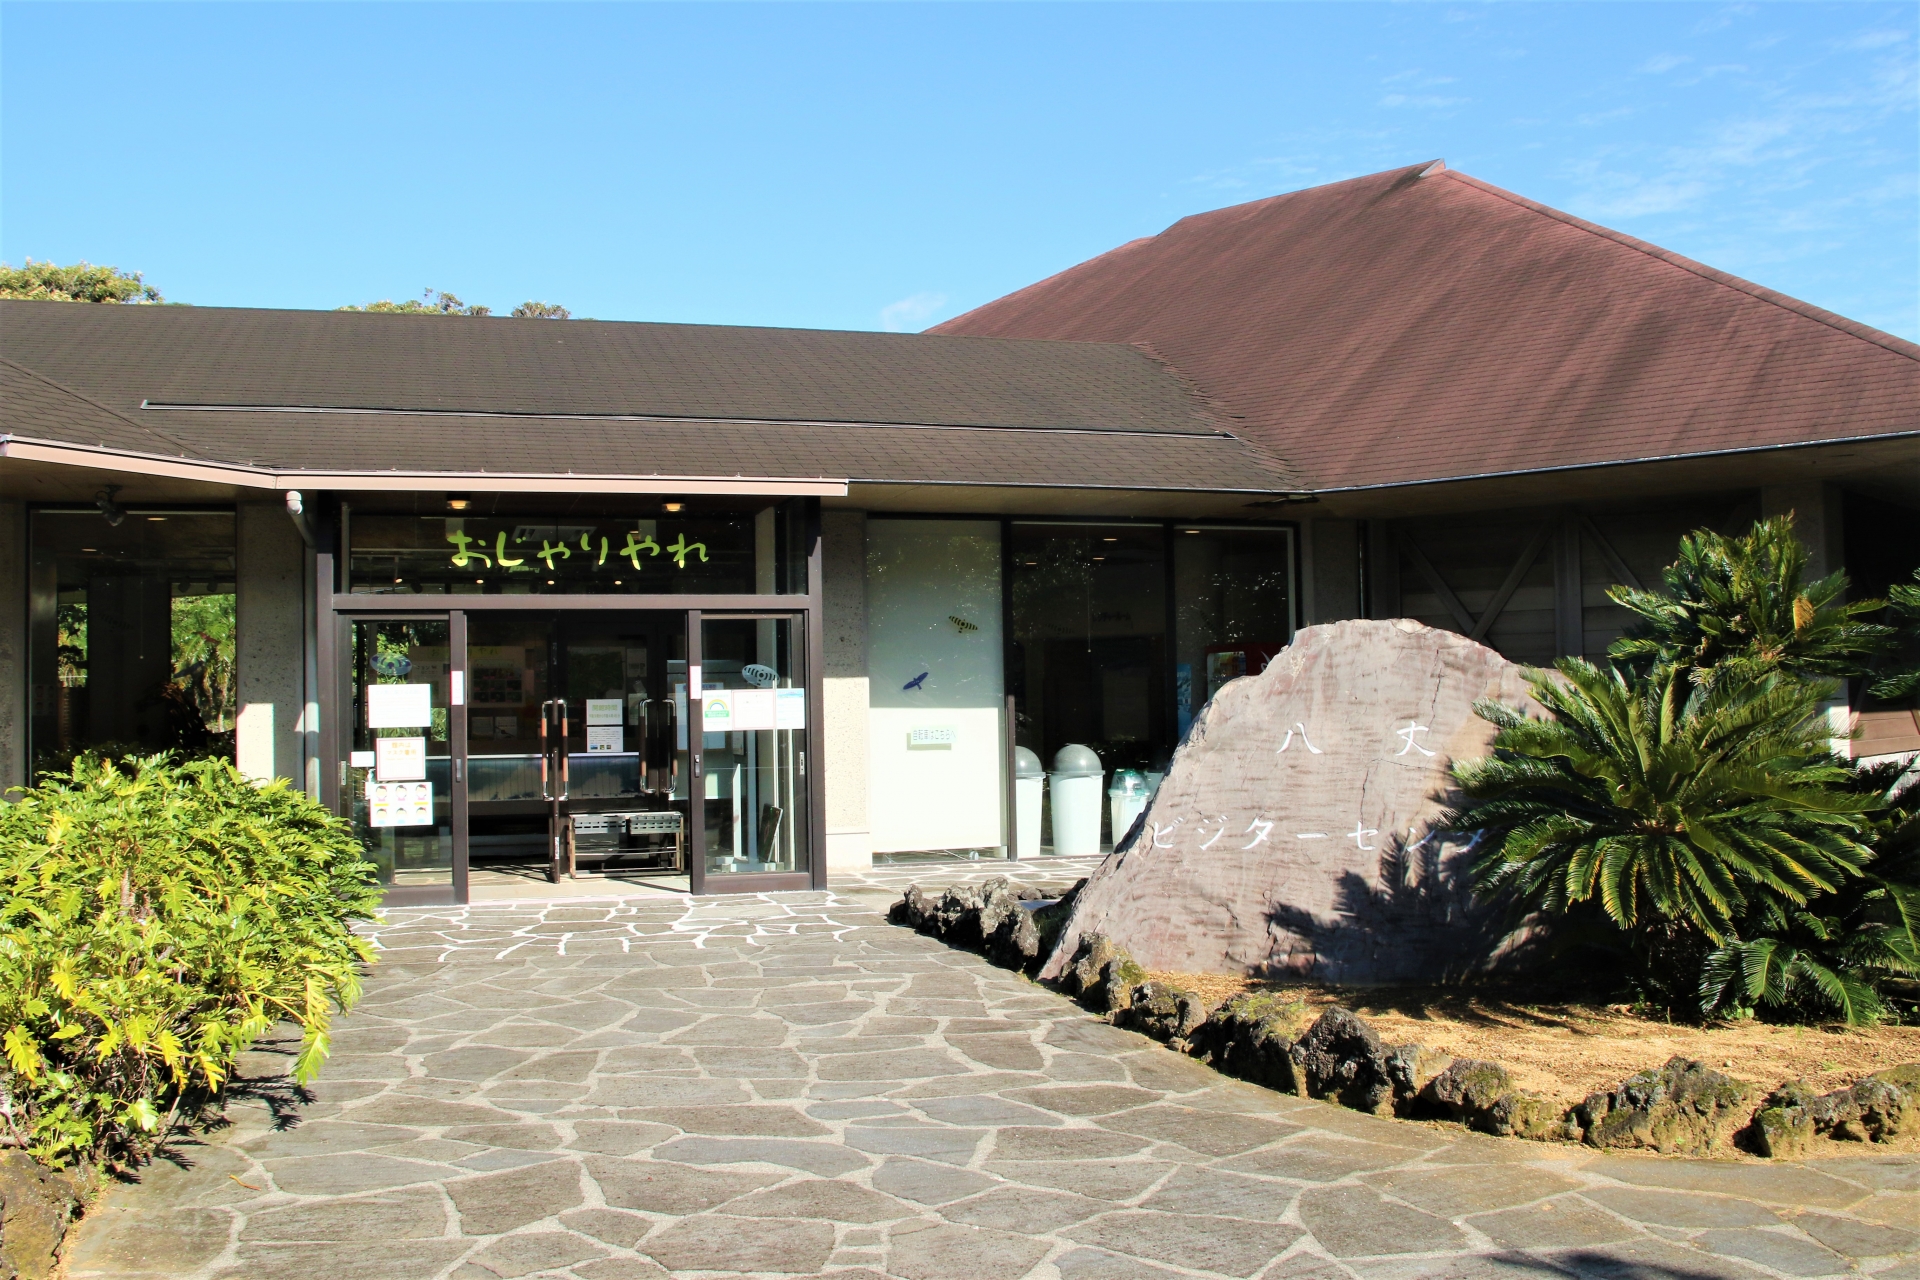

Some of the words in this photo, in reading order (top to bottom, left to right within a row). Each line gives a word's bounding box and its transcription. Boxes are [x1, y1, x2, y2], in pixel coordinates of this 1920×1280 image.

[447, 530, 709, 571] おじゃりやれ
[1277, 720, 1437, 757] 八丈
[1153, 815, 1485, 852] ビジターセンタ
